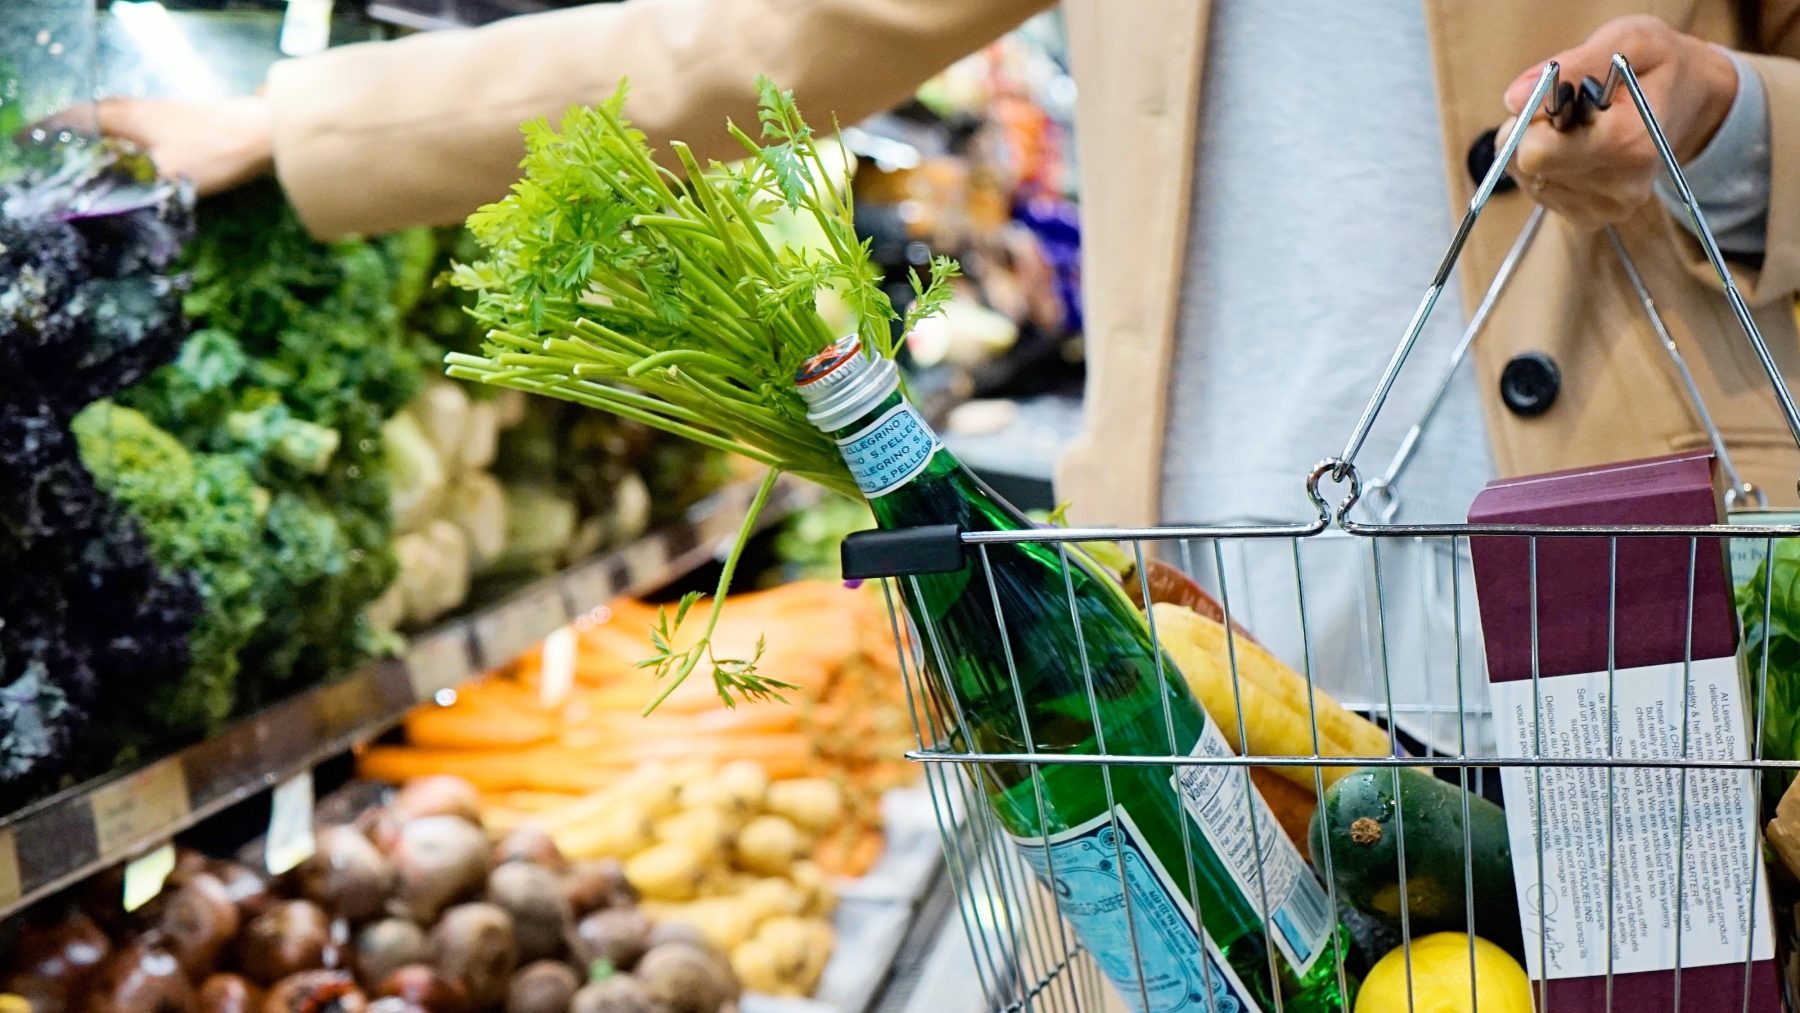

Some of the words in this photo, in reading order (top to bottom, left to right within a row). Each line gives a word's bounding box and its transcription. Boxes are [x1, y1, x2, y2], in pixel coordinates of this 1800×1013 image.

[1576, 687, 1586, 707] Seul
[1598, 692, 1606, 703] de
[1685, 679, 1698, 708] Lesley
[1708, 683, 1720, 722] delicious
[1719, 691, 1728, 701] At
[1516, 704, 1524, 725] vous
[1545, 695, 1557, 735] Délicieux
[1579, 710, 1586, 721] un
[1588, 701, 1596, 722] avec
[1635, 706, 1646, 738] cheese
[1645, 706, 1654, 720] but
[1655, 700, 1665, 724] these
[1719, 704, 1732, 732] Lesley
[1519, 727, 1525, 738] ne
[1590, 724, 1601, 744] soin,
[1646, 722, 1657, 746] really
[1668, 723, 1677, 731] A
[1692, 720, 1701, 734] her
[1550, 737, 1557, 748] au
[1580, 724, 1592, 754] produit
[1614, 736, 1624, 760] Stow
[1639, 741, 1646, 750] or
[1657, 727, 1669, 757] unique
[1694, 737, 1704, 759] team
[1704, 732, 1712, 746] are
[1594, 747, 1601, 758] en
[1717, 749, 1727, 775] The
[1523, 776, 1534, 795] plus
[1545, 775, 1554, 787] de
[1654, 774, 1664, 797] when
[1689, 774, 1700, 806] scratch
[1710, 776, 1719, 794] with
[1567, 781, 1578, 809] POUR
[1621, 787, 1631, 814] Foods
[1647, 796, 1656, 810] We
[1701, 786, 1710, 799] the
[1720, 778, 1732, 815] fabulous
[1732, 787, 1743, 815] Foods
[1528, 797, 1536, 817] vous
[1546, 788, 1560, 832] trempette,
[1588, 790, 1602, 825] fabriqué
[1656, 800, 1668, 830] topped
[1701, 802, 1712, 820] only
[1713, 796, 1721, 815] care
[1557, 803, 1572, 848] craquelins
[1571, 812, 1581, 832] CES
[1581, 800, 1593, 840] satisfaire
[1613, 806, 1625, 841] fabuleux
[1624, 816, 1635, 841] adore
[1639, 815, 1647, 833] sure
[1692, 808, 1704, 831] using
[1716, 818, 1724, 826] in
[1724, 817, 1736, 843] crisps
[1736, 817, 1743, 830] we
[1553, 834, 1562, 845] de
[1595, 827, 1603, 848] avec
[1662, 832, 1671, 849] with
[1704, 822, 1713, 840] way
[1717, 828, 1727, 851] small
[1738, 832, 1747, 850] love
[1574, 834, 1584, 857] FINS
[1640, 836, 1649, 852] you
[1651, 829, 1663, 866] addicted
[1708, 842, 1716, 850] to
[1553, 848, 1567, 883] fromage
[1565, 850, 1575, 869] sont
[1585, 842, 1597, 870] Lesley
[1598, 850, 1607, 866] des
[1626, 844, 1640, 882] fabriquer
[1644, 854, 1653, 868] will
[1663, 852, 1672, 870] your
[1699, 850, 1709, 873] finest
[1710, 853, 1720, 876] make
[1729, 845, 1739, 865] from
[1590, 872, 1599, 880] et
[1616, 844, 1631, 889] craquelins
[1646, 870, 1655, 881] be
[1656, 869, 1664, 877] to
[1560, 886, 1567, 897] ou
[1568, 871, 1581, 919] irrésistibles
[1577, 859, 1593, 923] CRAQUELINS
[1633, 884, 1642, 893] et
[1658, 880, 1667, 895] this
[1731, 868, 1744, 902] Lesley's
[1615, 902, 1623, 914] de
[1624, 891, 1634, 910] sont
[1635, 895, 1643, 916] vous
[1713, 887, 1724, 910] great
[1658, 898, 1670, 929] yummy
[1683, 914, 1691, 931] own
[1737, 904, 1748, 936] kitchen
[1625, 912, 1639, 952] fabriqués
[1638, 918, 1648, 938] offrir
[1716, 912, 1729, 944] product
[1573, 921, 1587, 959] lorsqu'ils
